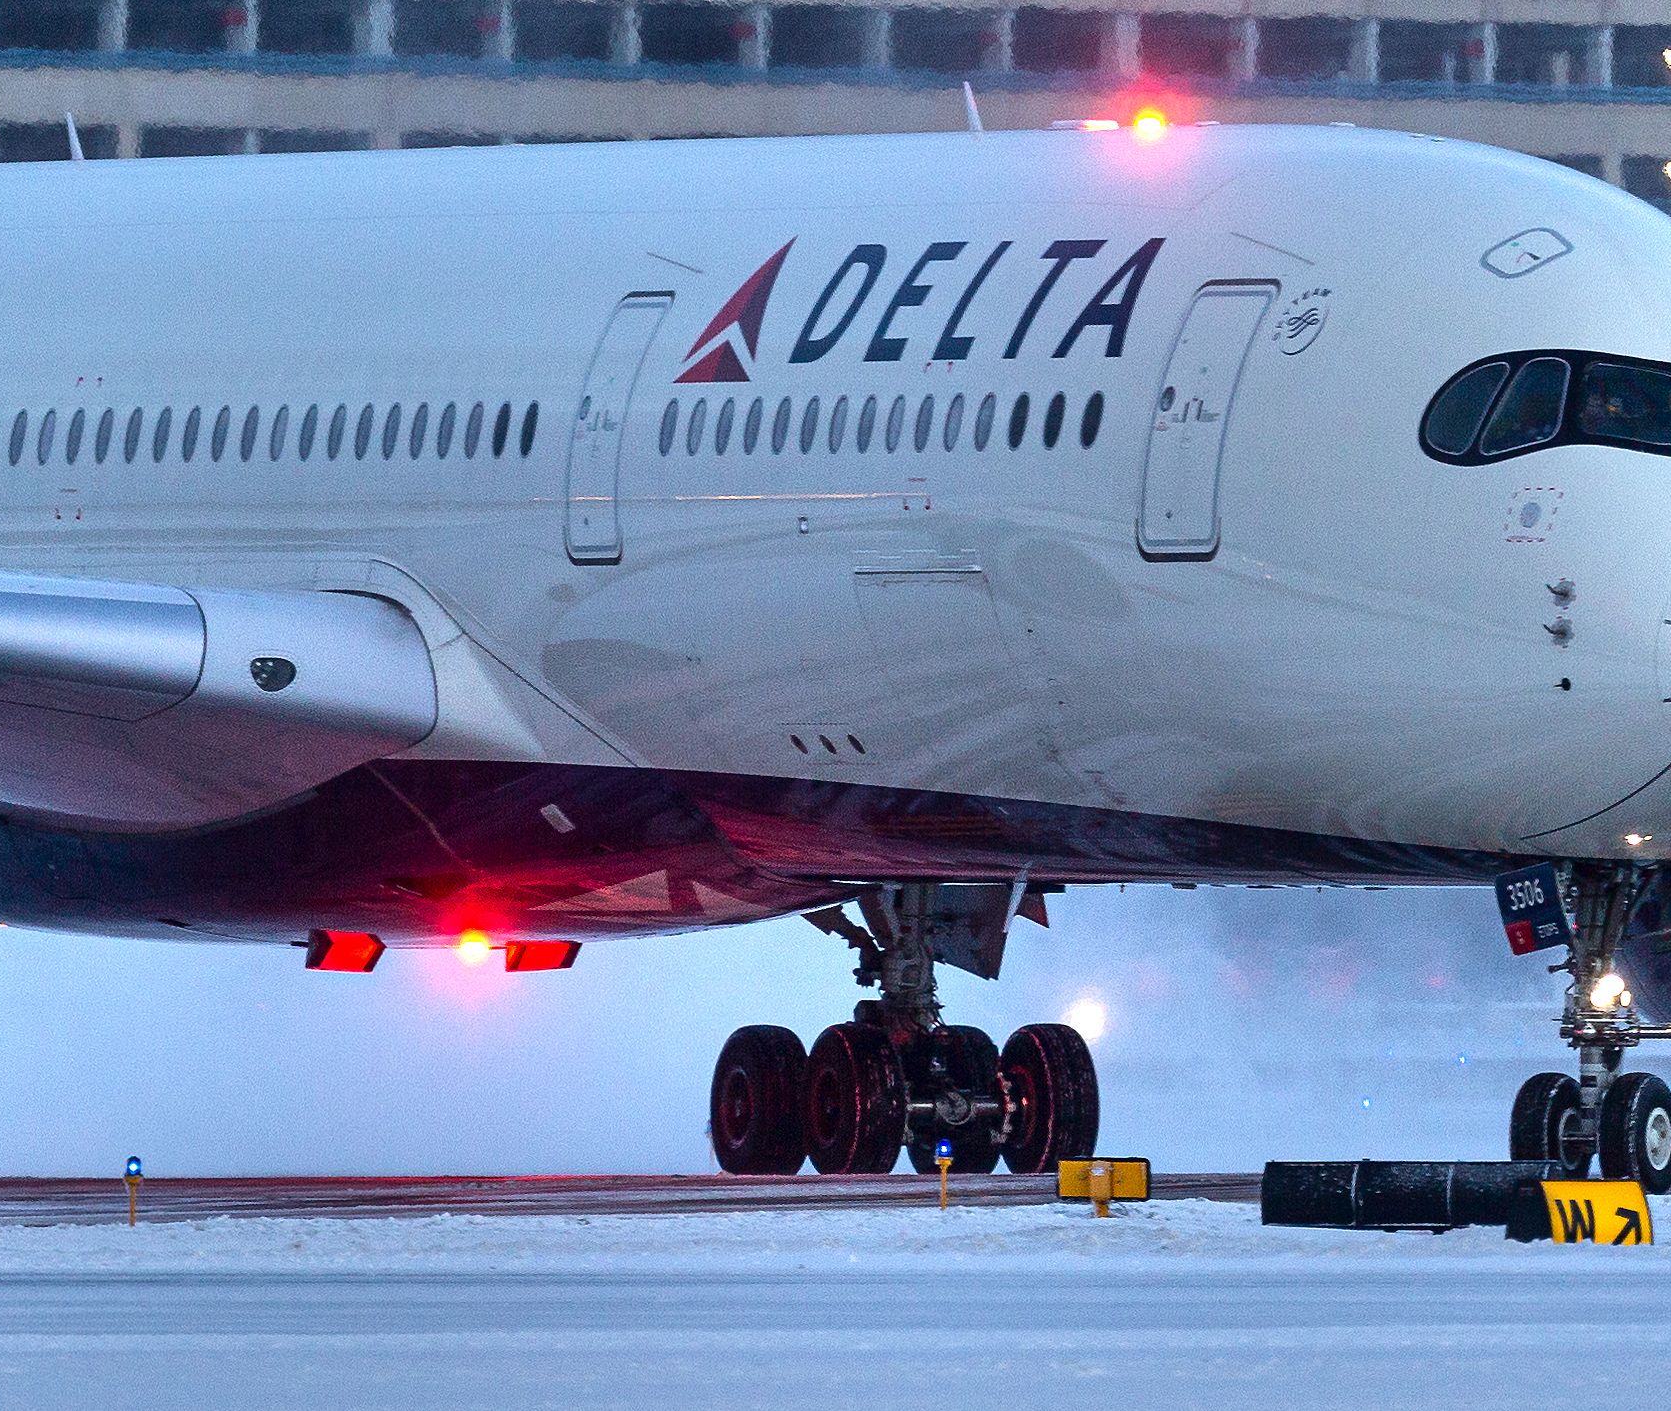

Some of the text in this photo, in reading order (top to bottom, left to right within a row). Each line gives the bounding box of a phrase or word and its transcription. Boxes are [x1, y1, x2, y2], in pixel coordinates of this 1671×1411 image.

[788, 237, 1167, 364] DELTA
[1506, 878, 1545, 911] 3506
[1554, 1199, 1596, 1244] W
